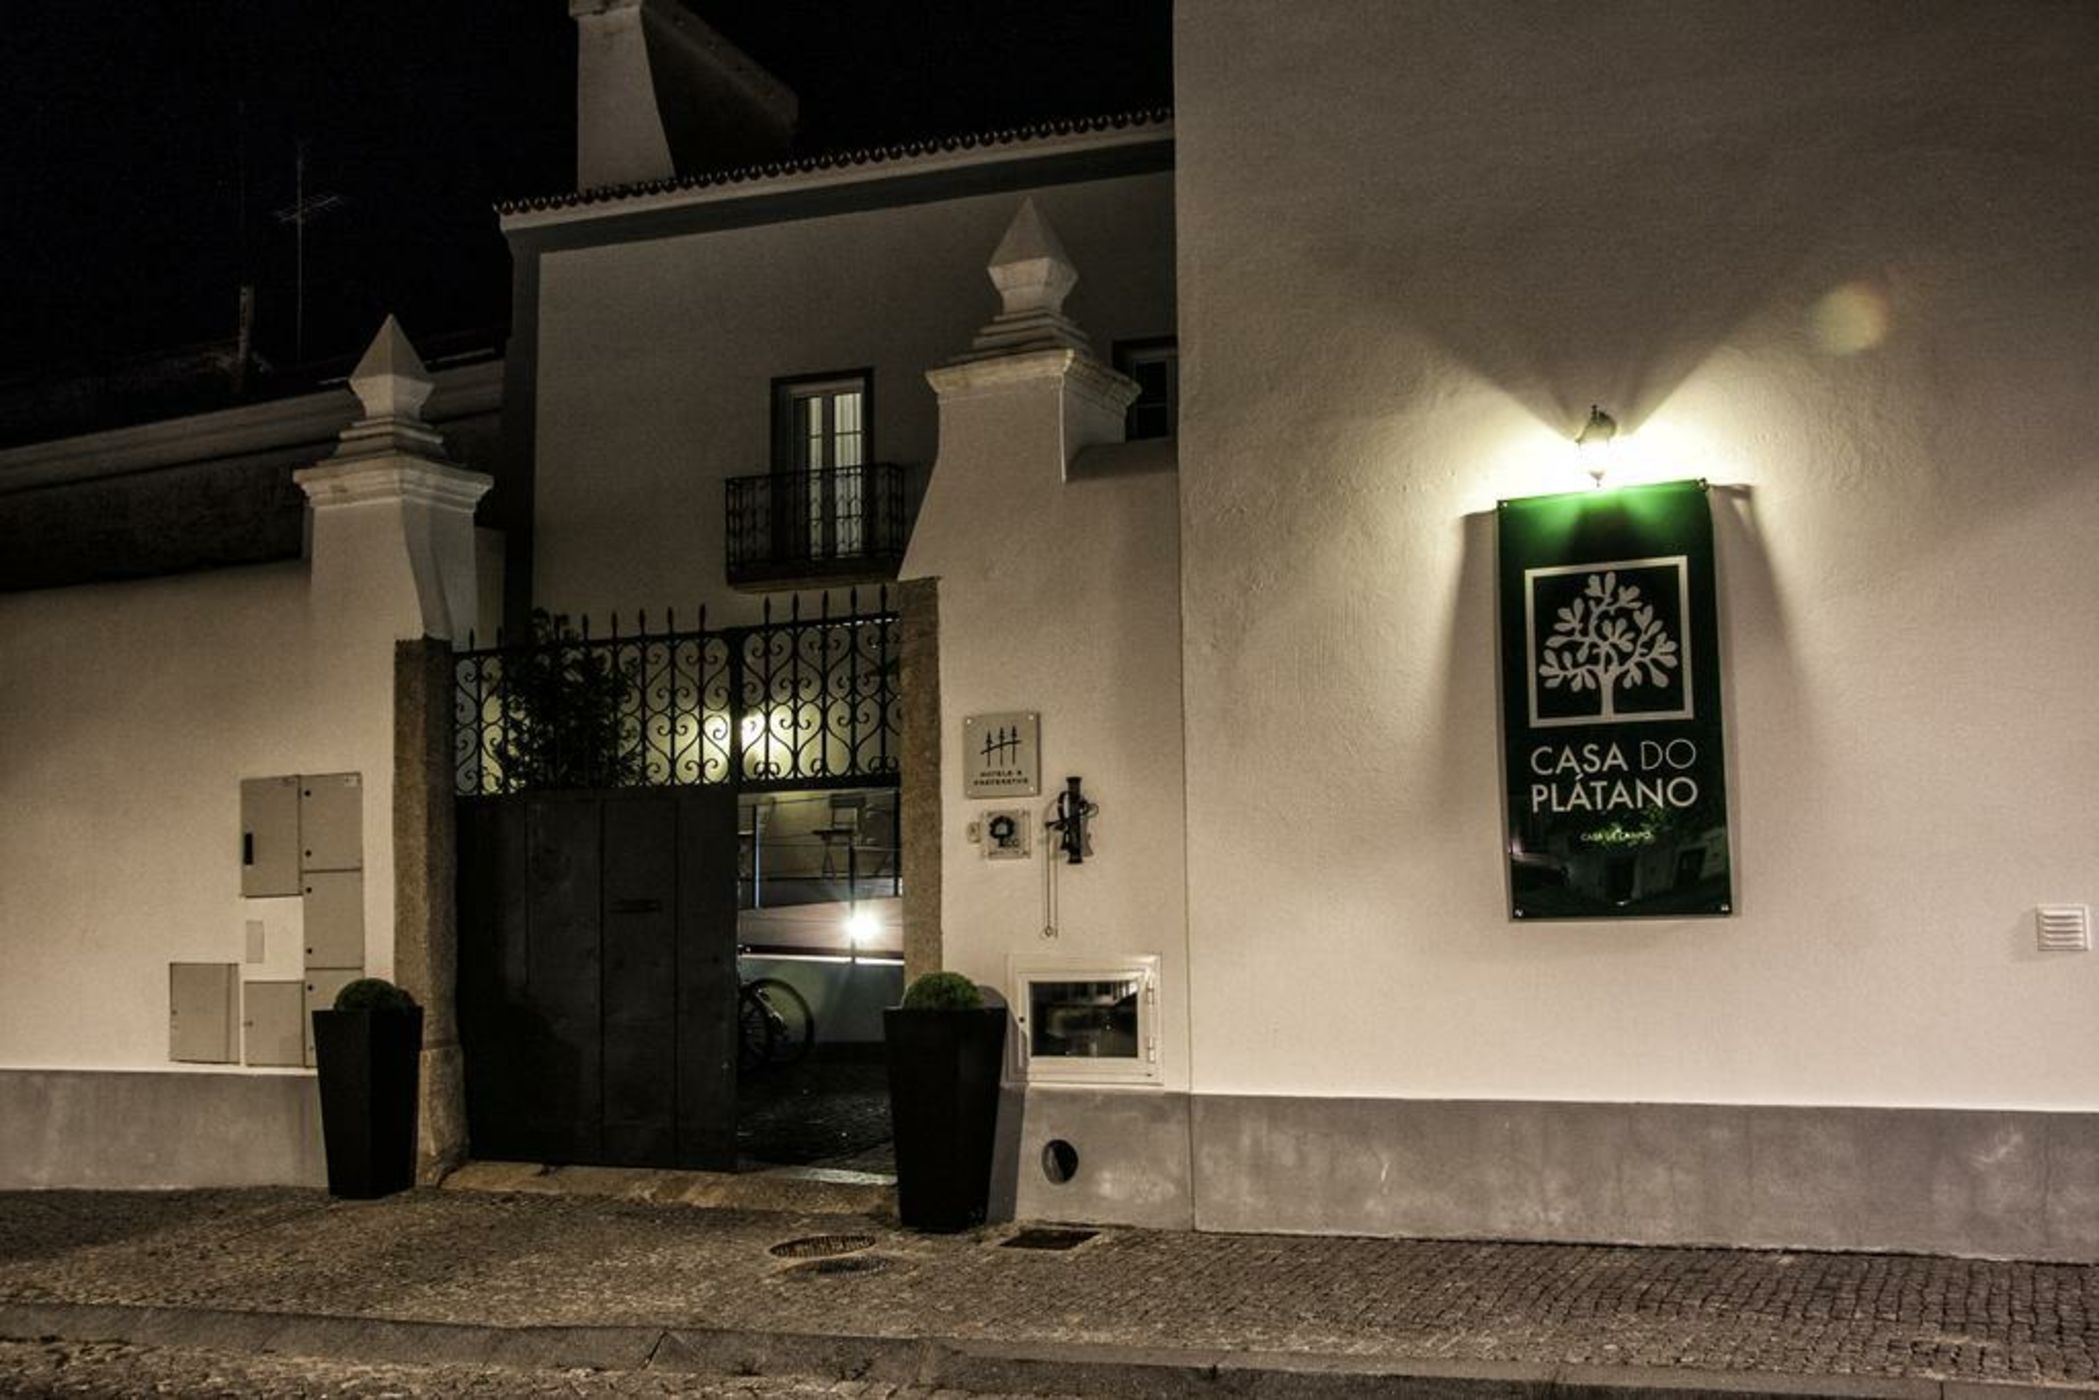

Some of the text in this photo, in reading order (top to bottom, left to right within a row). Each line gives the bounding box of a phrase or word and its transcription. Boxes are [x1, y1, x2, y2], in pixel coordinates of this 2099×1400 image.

[1530, 738, 1697, 775] CASA DO
[1531, 773, 1699, 813] PLÁTANO
